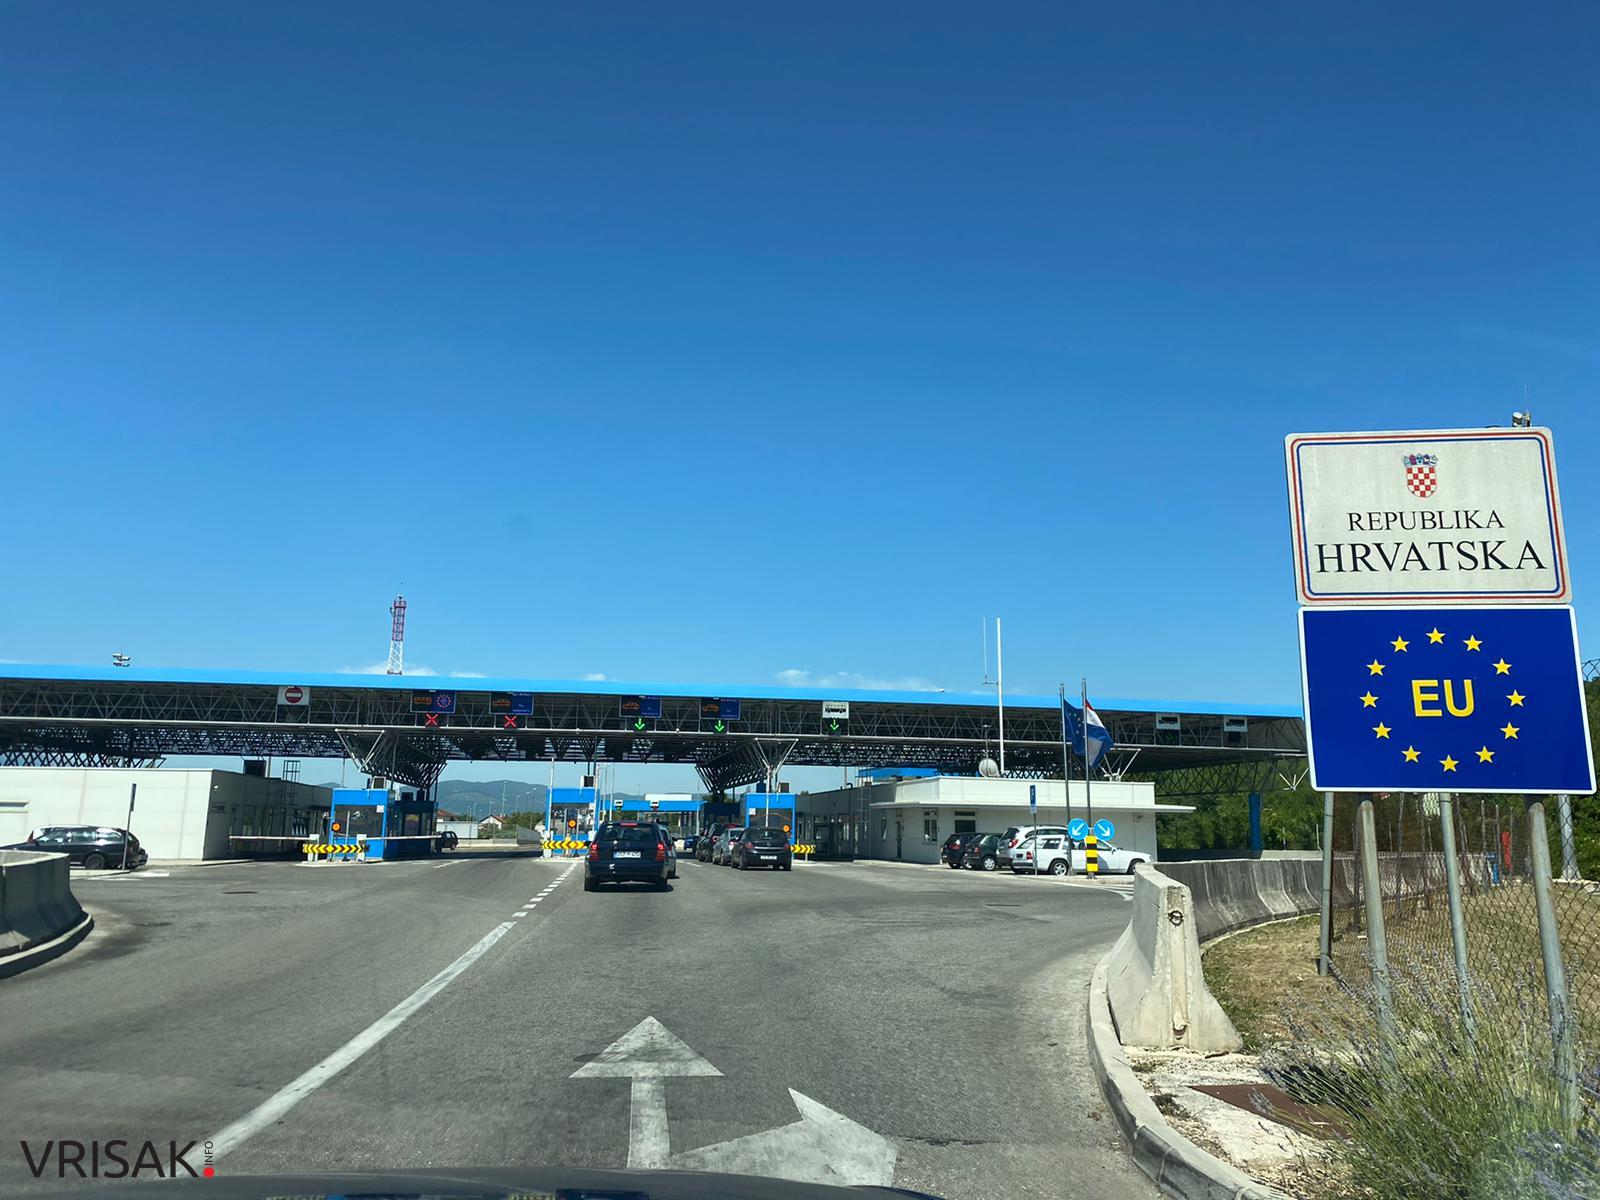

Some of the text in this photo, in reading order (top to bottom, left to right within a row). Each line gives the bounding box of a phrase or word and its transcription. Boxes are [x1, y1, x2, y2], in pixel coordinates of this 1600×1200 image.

[1348, 510, 1505, 531] REPUBLIKA
[1315, 540, 1547, 573] HRVATSKA
[1412, 679, 1475, 717] EU
